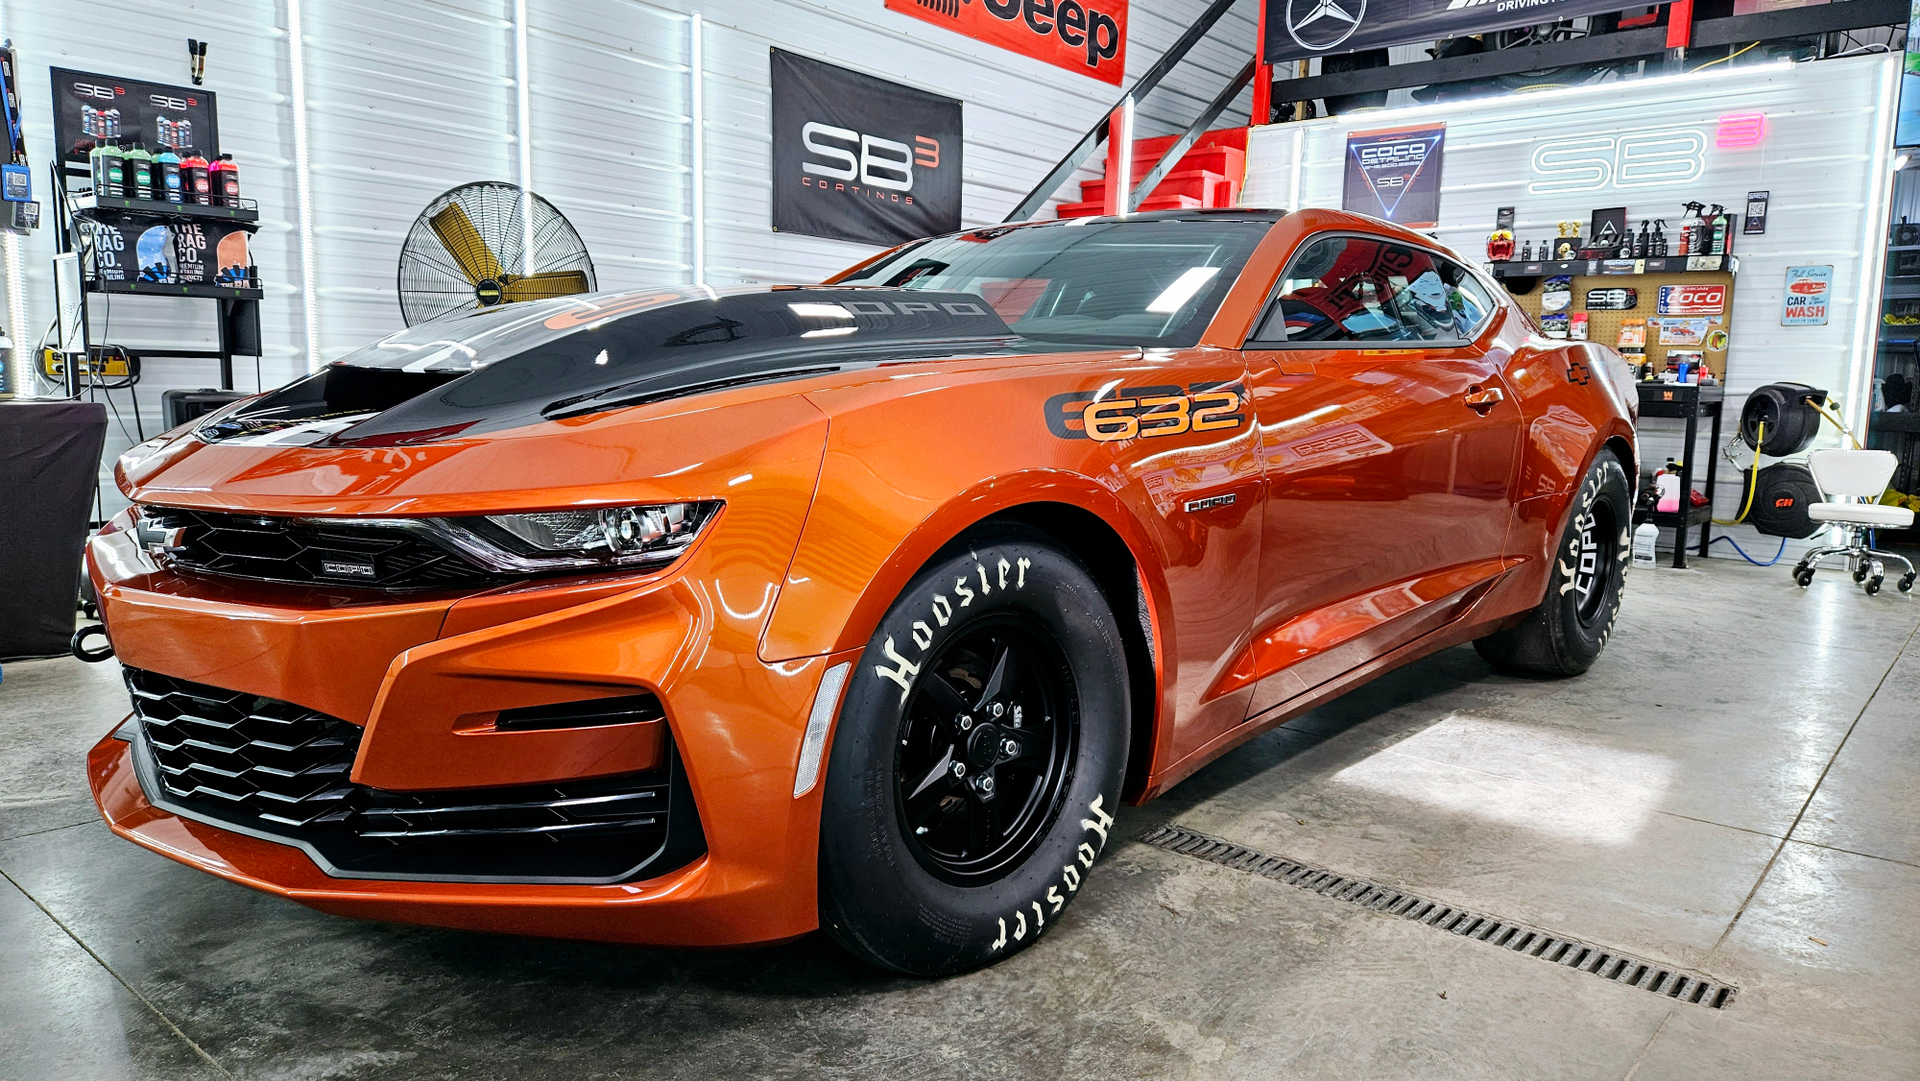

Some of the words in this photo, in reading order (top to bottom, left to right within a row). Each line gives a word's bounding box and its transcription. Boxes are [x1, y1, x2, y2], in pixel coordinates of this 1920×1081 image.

[1362, 143, 1426, 158] COCO
[1361, 154, 1425, 165] DETAILING
[802, 176, 914, 205] COATINGS
[96, 222, 121, 235] HE
[177, 233, 206, 250] RAG
[178, 247, 203, 263] CO.
[1666, 292, 1722, 304] COCO
[1787, 296, 1806, 305] CAR
[787, 301, 987, 316] OPO
[1785, 305, 1825, 318] WASH
[1083, 391, 1240, 442] 632
[1184, 493, 1236, 513] COPO
[324, 563, 374, 575] COPO
[874, 551, 1031, 706] Hoosier
[993, 794, 1114, 952] Hoosier
